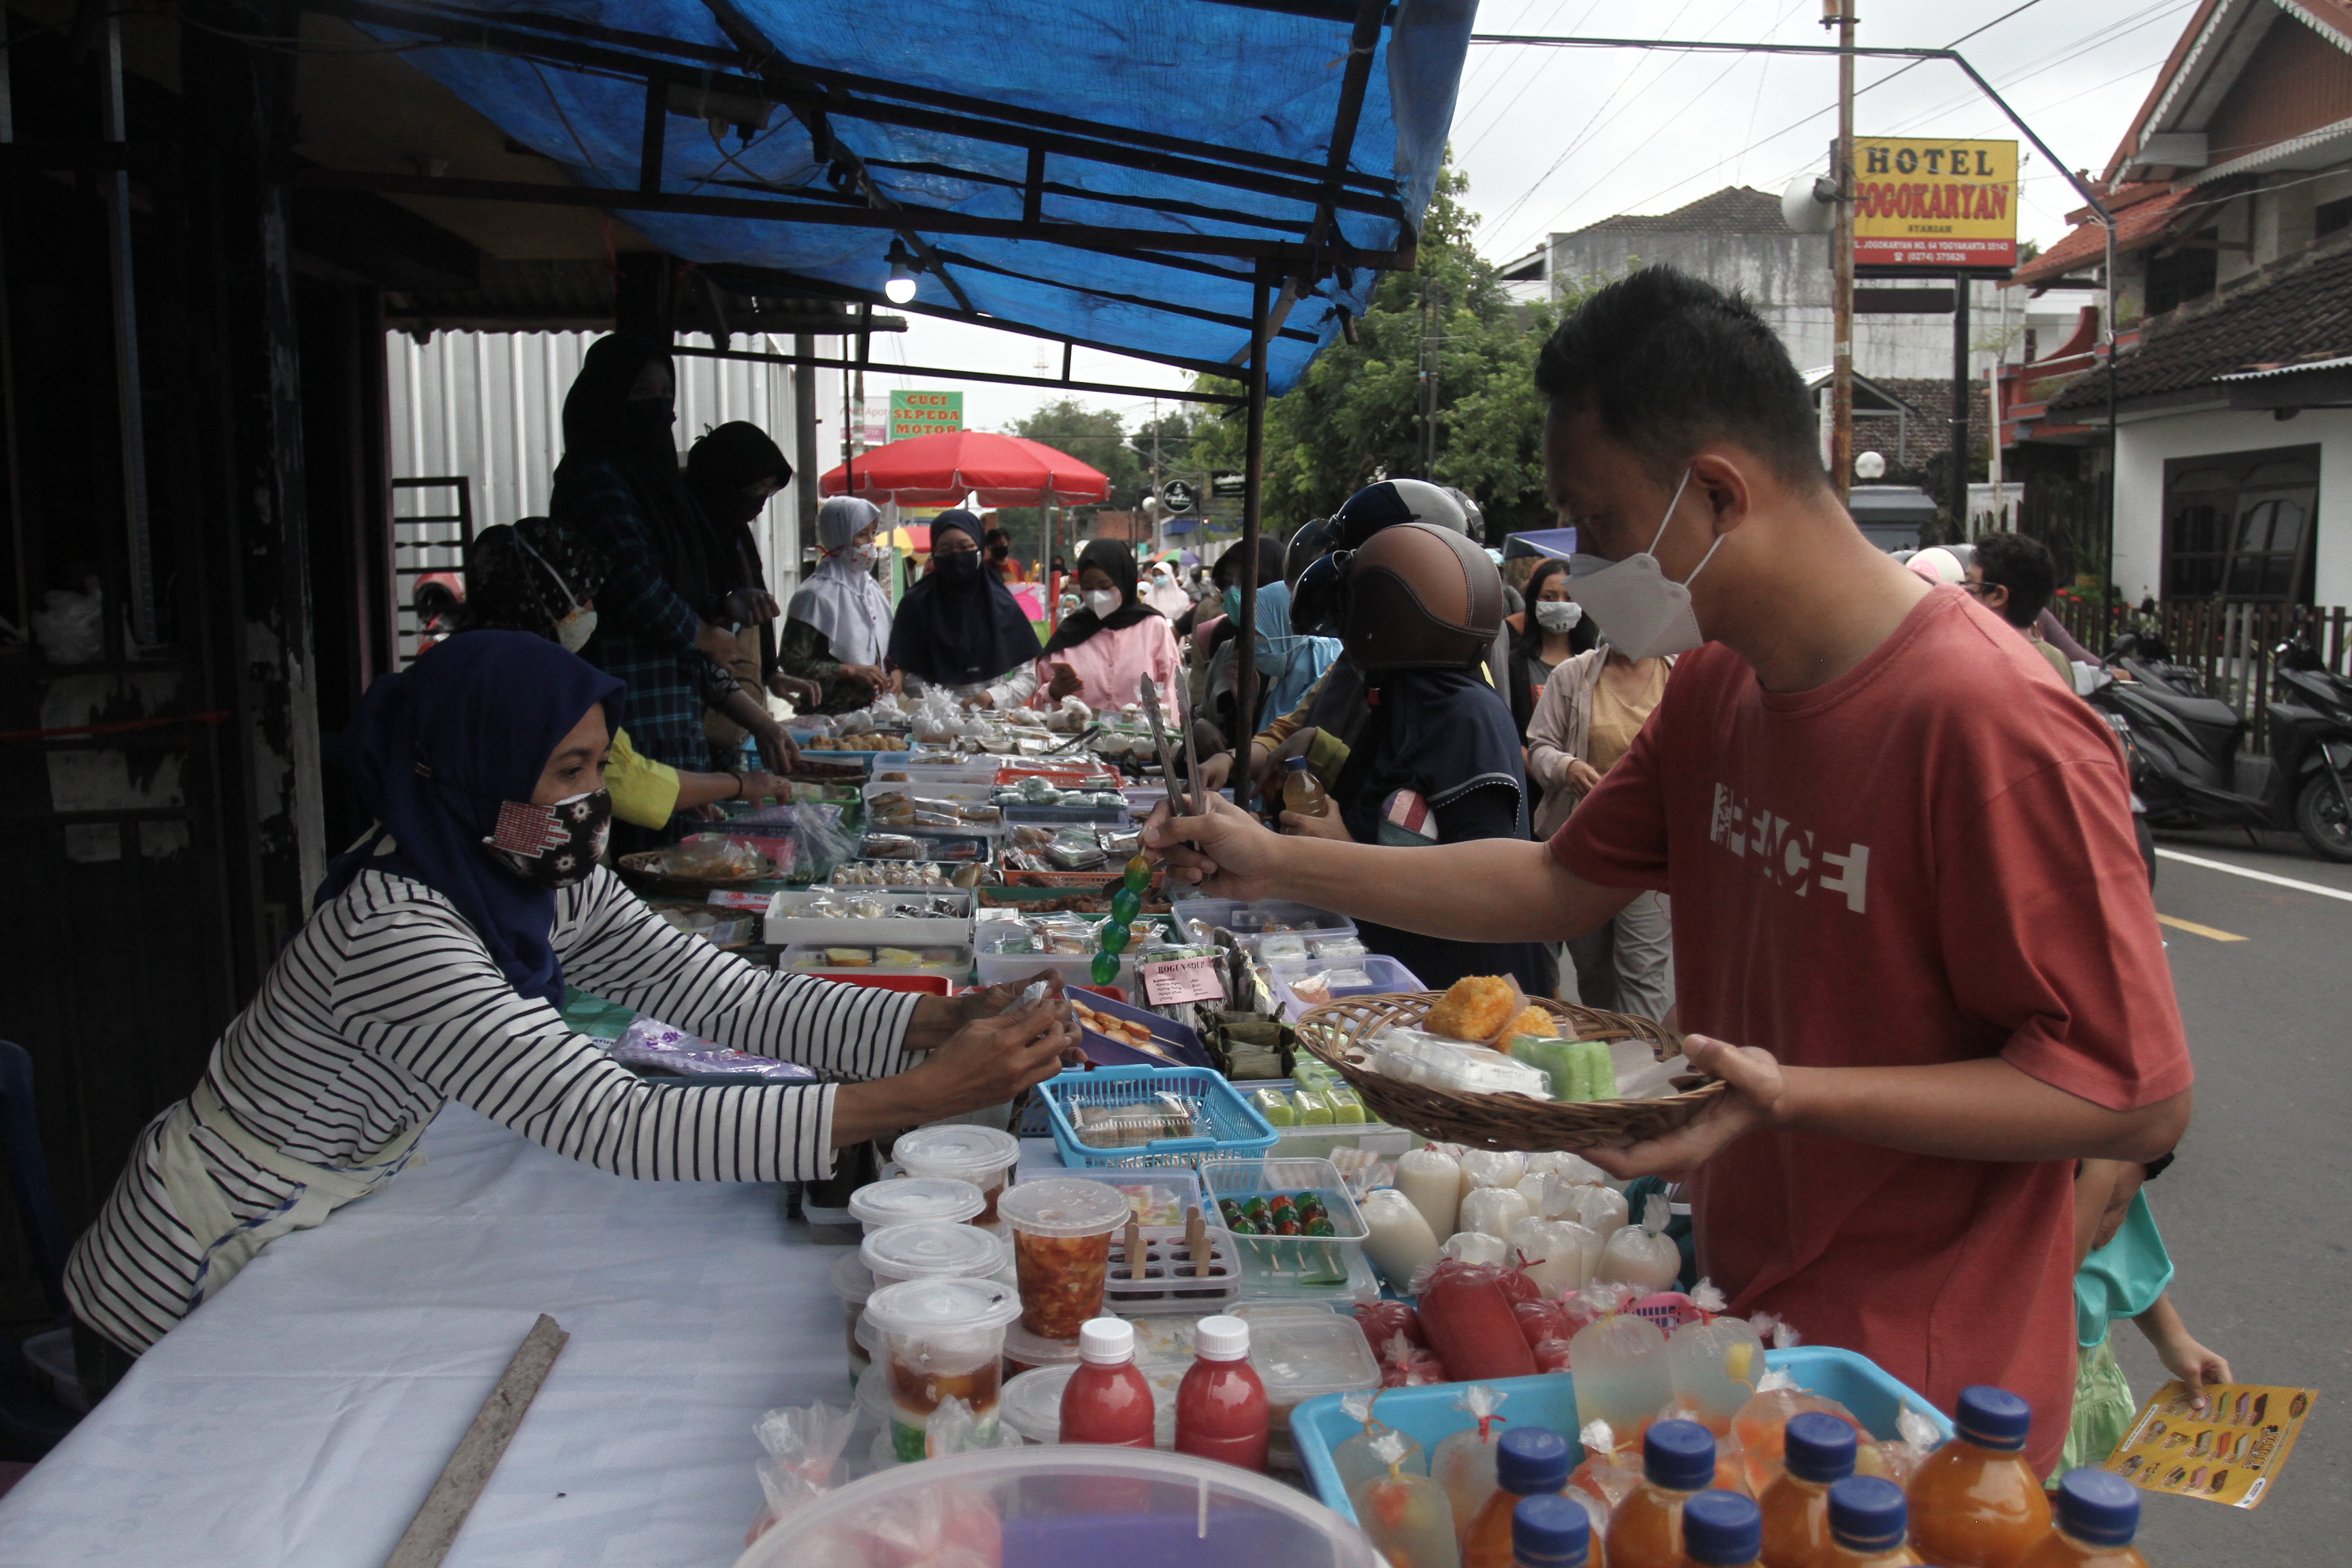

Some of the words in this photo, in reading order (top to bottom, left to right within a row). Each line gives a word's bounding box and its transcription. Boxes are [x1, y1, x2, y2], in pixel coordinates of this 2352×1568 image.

[1866, 147, 1994, 176] HOTEL
[1855, 182, 2009, 220] JOGOKARYAN
[906, 395, 948, 406] CUCI
[893, 409, 960, 421] SEPEDA
[895, 424, 958, 435] MOTOR
[1187, 961, 1205, 970] SOUP
